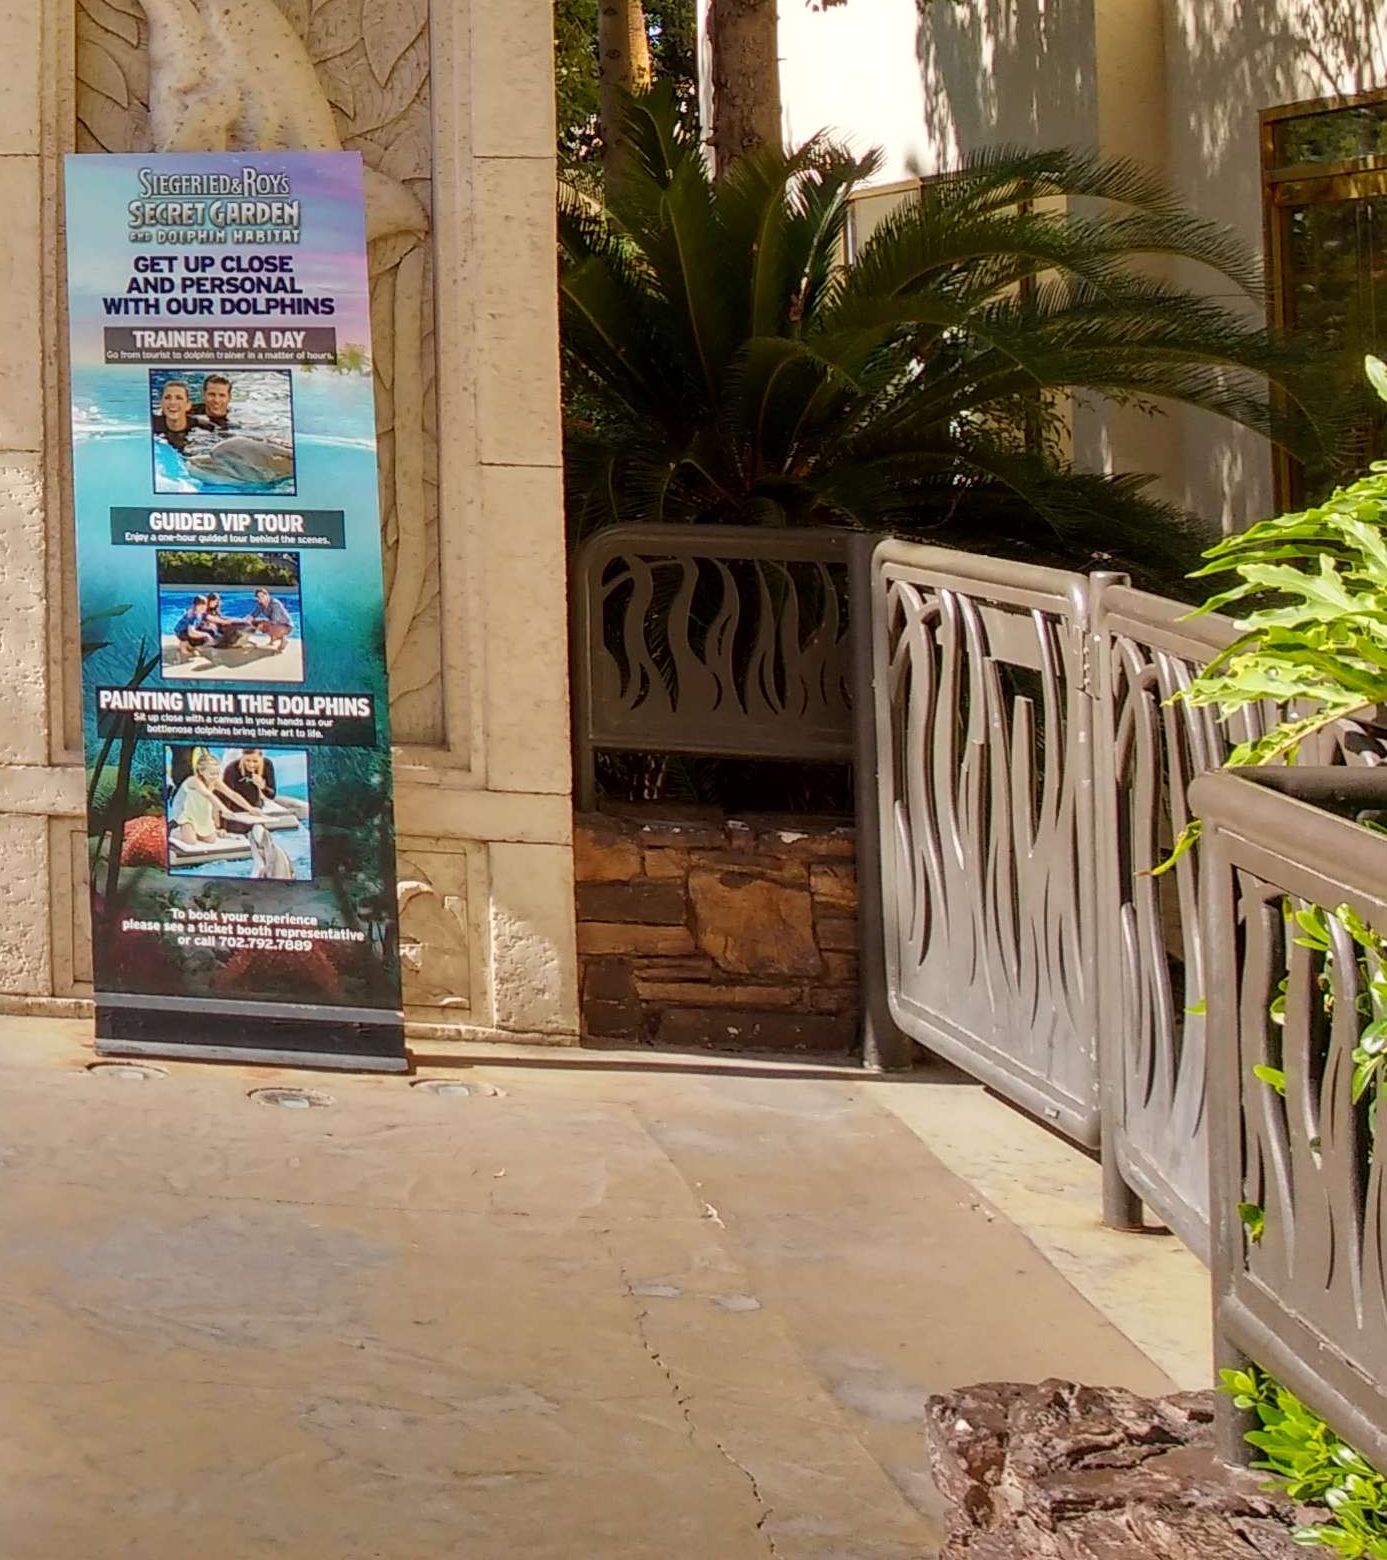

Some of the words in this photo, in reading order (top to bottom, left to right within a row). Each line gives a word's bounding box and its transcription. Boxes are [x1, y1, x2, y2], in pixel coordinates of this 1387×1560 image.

[129, 200, 205, 228] SECRET
[210, 200, 299, 228] GARDEN
[158, 230, 226, 244] DOLPHIN
[233, 230, 300, 244] HABITAT
[134, 256, 177, 273] GET
[184, 256, 215, 273] UP
[220, 256, 293, 273] CLOSE
[127, 277, 175, 294] AND
[181, 277, 303, 294] PERSONAL
[102, 298, 160, 315] WITH
[166, 298, 214, 315] OUR
[220, 298, 335, 315] DOLPHINS
[132, 331, 210, 348] TRAINER
[213, 331, 248, 348] FOR
[250, 331, 266, 348] A
[270, 331, 306, 348] DAY
[106, 350, 118, 359] Go
[120, 350, 140, 359] from
[142, 350, 171, 359] tourist
[172, 351, 182, 359] to
[183, 350, 215, 361] dolphin
[216, 350, 246, 360] trainer
[247, 351, 255, 360] in
[257, 352, 263, 360] a
[265, 351, 294, 360] matter
[296, 351, 306, 360] of
[149, 512, 216, 531] GUIDED
[220, 513, 251, 532] VIP
[254, 514, 304, 533] TOUR
[124, 532, 149, 543] Enjoy
[198, 533, 228, 544] guided
[229, 534, 248, 543] tour
[250, 534, 279, 544] behind
[281, 535, 295, 544] the
[100, 690, 184, 710] PAINTING
[187, 692, 236, 713] WITH
[237, 694, 275, 714] THE
[278, 696, 371, 717] DOLPHINS
[148, 714, 159, 723] up
[161, 713, 183, 723] close
[185, 714, 205, 723] with
[206, 716, 212, 724] a
[245, 716, 254, 725] in
[255, 718, 275, 727] your
[277, 717, 303, 726] hands
[147, 724, 193, 734] bottlenose
[194, 725, 231, 736] dolphins
[233, 726, 256, 738] bring
[257, 727, 278, 737] their
[280, 729, 294, 738] art
[296, 729, 305, 738] to
[171, 908, 185, 920] To
[189, 909, 218, 921] book
[221, 913, 248, 924] your
[252, 913, 317, 927] experience
[122, 919, 160, 932] please
[164, 922, 184, 932] see
[187, 923, 195, 932] a
[198, 921, 233, 934] ticket
[236, 923, 272, 936] booth
[275, 926, 365, 941] representative
[178, 935, 191, 945] or
[194, 935, 216, 946] call
